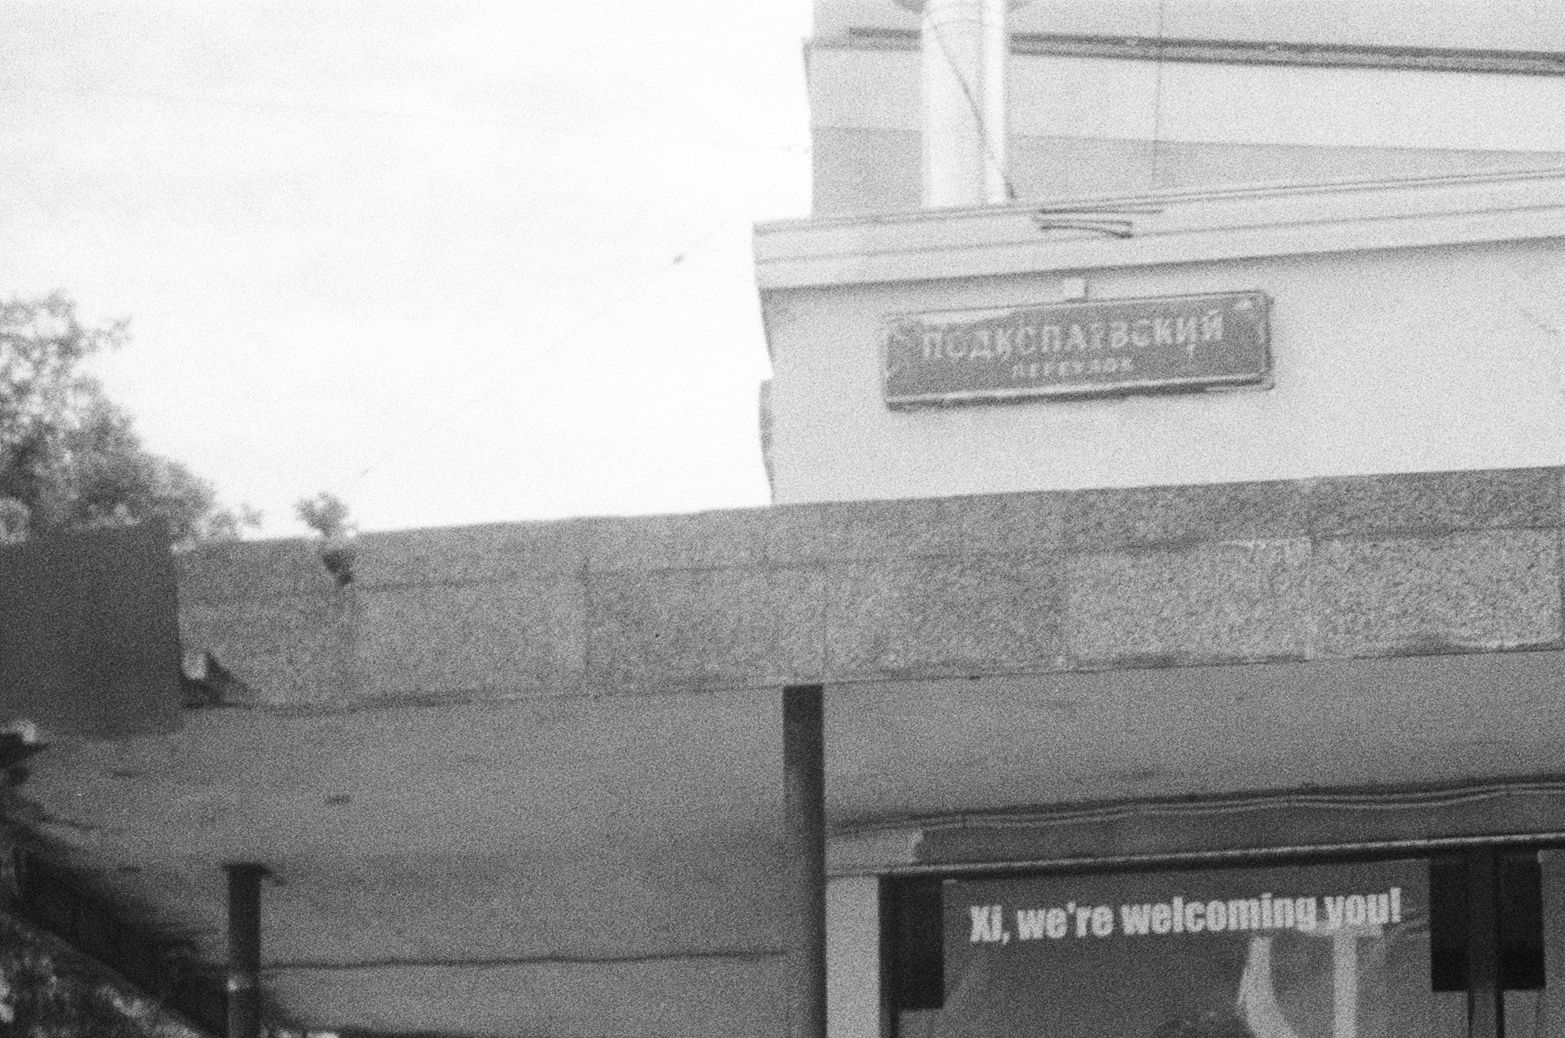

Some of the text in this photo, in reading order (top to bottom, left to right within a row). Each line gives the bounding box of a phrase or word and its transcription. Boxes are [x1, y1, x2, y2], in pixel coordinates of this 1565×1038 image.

[970, 887, 1401, 944] Xi, we're welcoming you!
